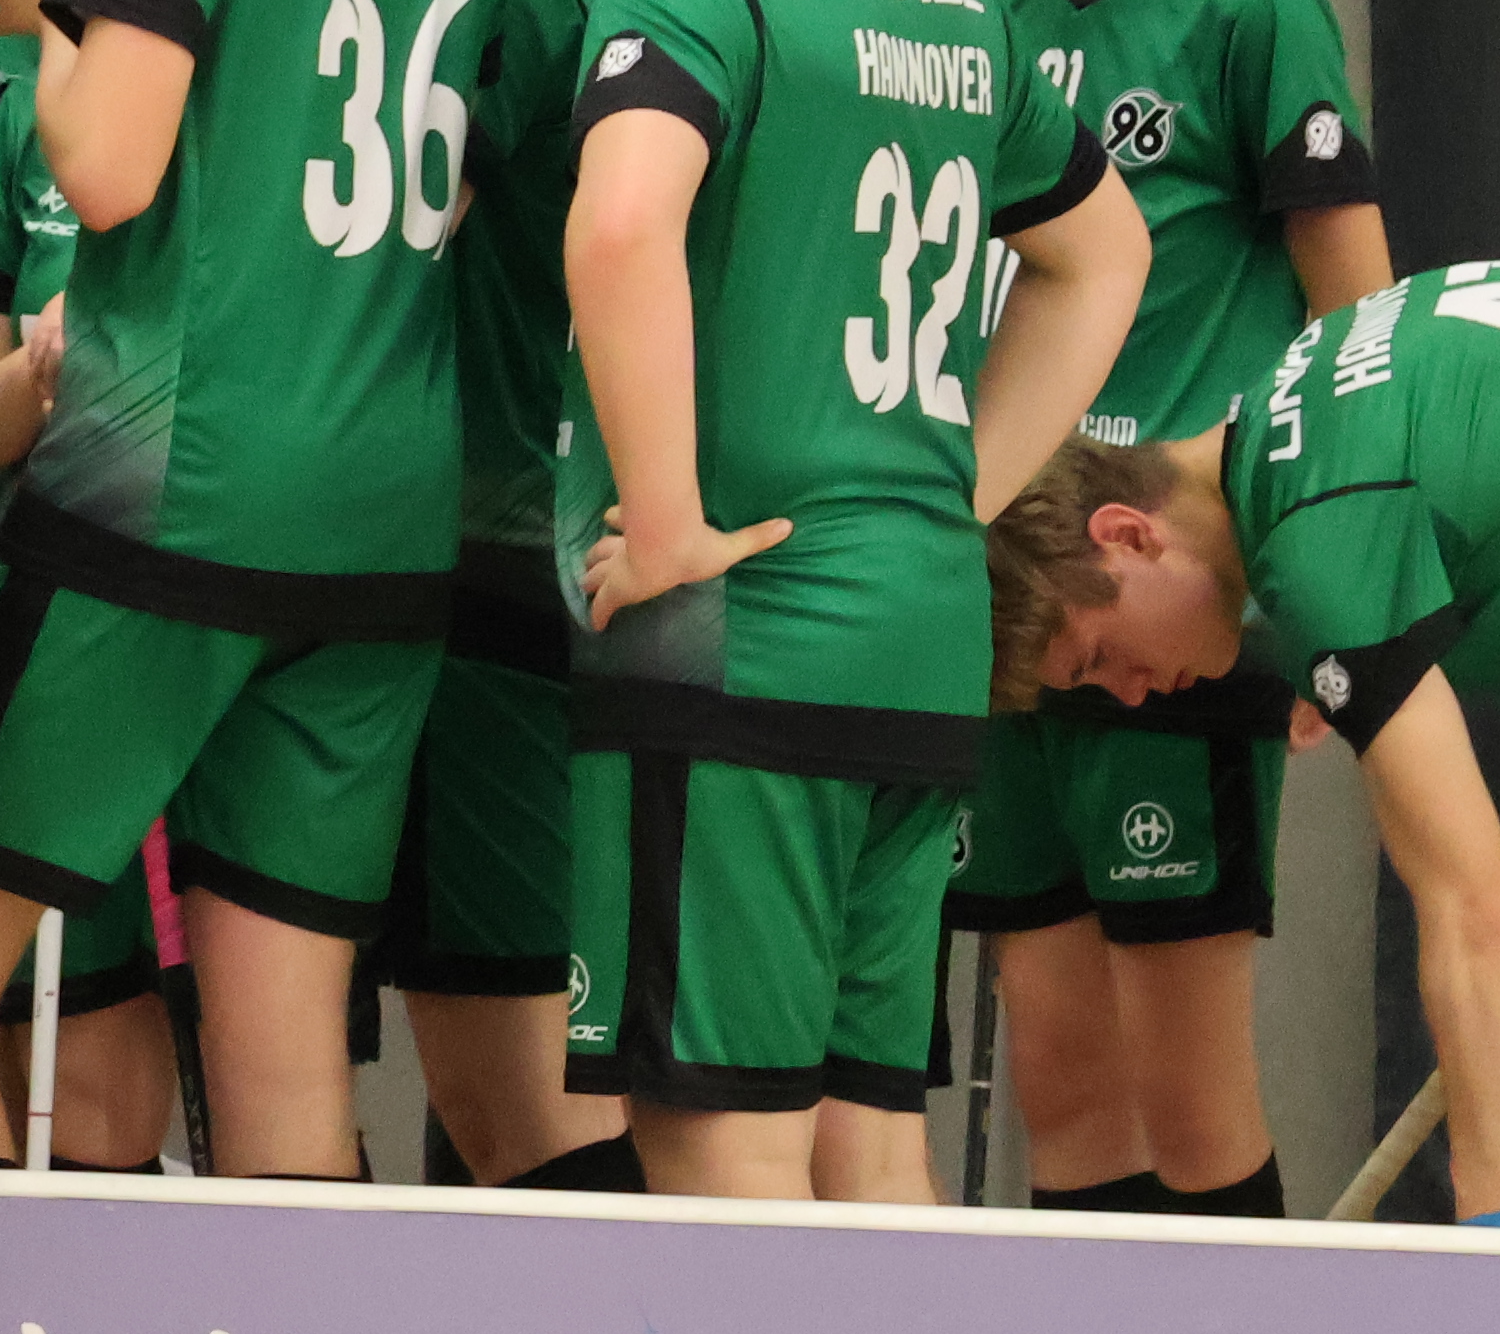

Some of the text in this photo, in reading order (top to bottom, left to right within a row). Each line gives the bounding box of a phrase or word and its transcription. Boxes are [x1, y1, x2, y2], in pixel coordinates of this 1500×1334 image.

[852, 27, 993, 117] HANNOVER
[1106, 95, 1172, 160] 96
[843, 140, 972, 428] 32
[1109, 859, 1200, 882] UNIHOC
